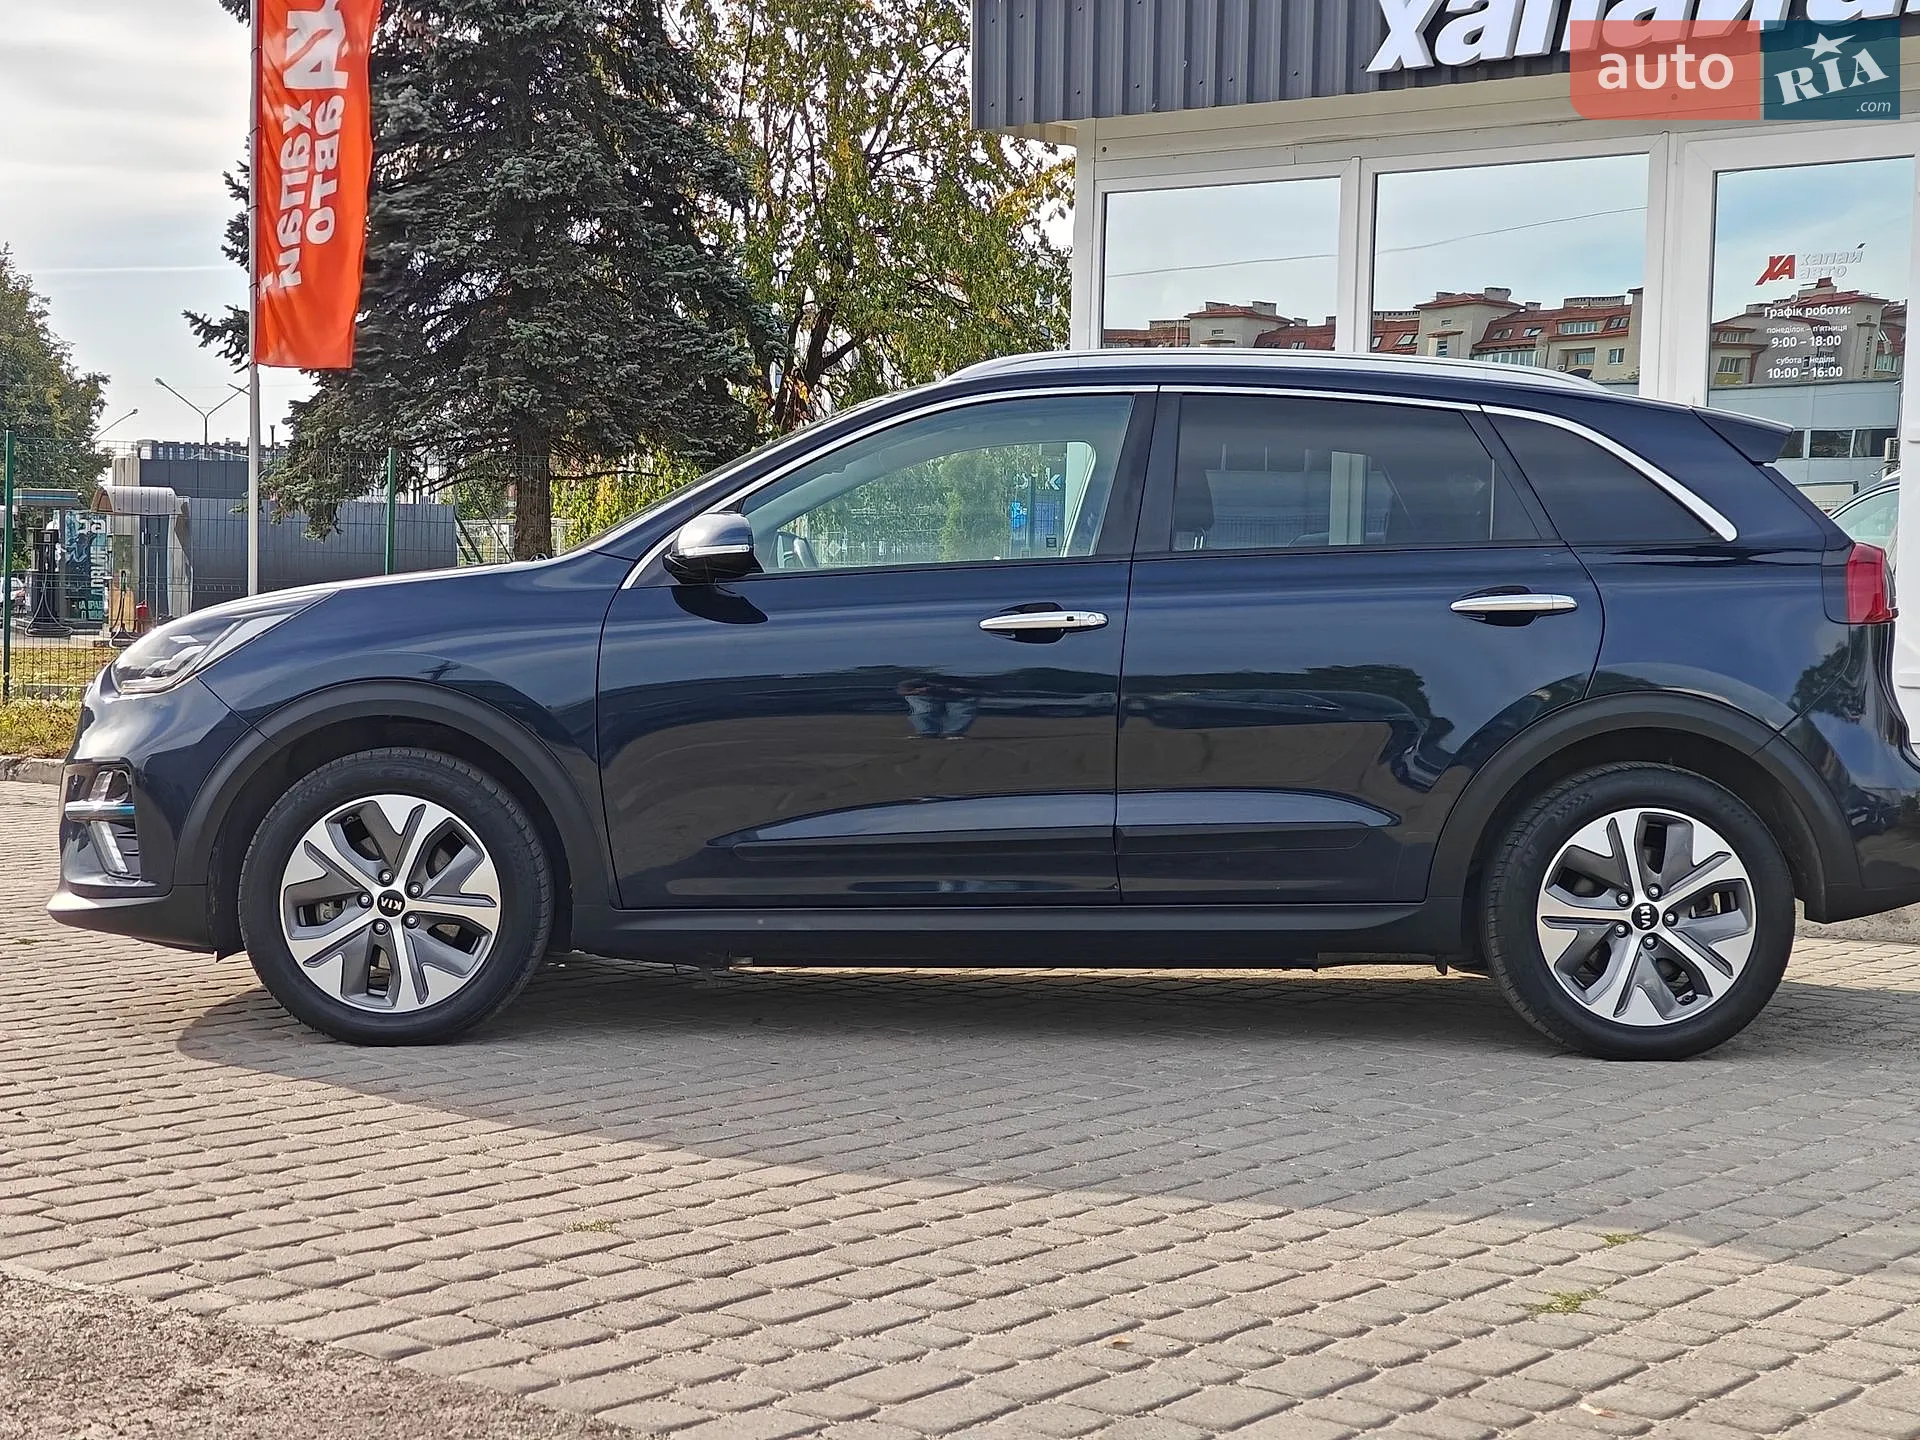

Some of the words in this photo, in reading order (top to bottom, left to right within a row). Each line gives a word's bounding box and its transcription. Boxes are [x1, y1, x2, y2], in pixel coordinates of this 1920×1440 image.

[1764, 306, 1803, 319] Графік
[1805, 304, 1852, 317] роботи:
[1766, 325, 1805, 334] понеділок
[1771, 337, 1797, 348] 9:00
[1809, 335, 1842, 347] 18:00
[1776, 356, 1802, 366] субота
[1767, 368, 1799, 379] 10:00
[1810, 366, 1843, 378] 16:00
[380, 896, 402, 910] KIA
[1639, 906, 1651, 928] KIA
